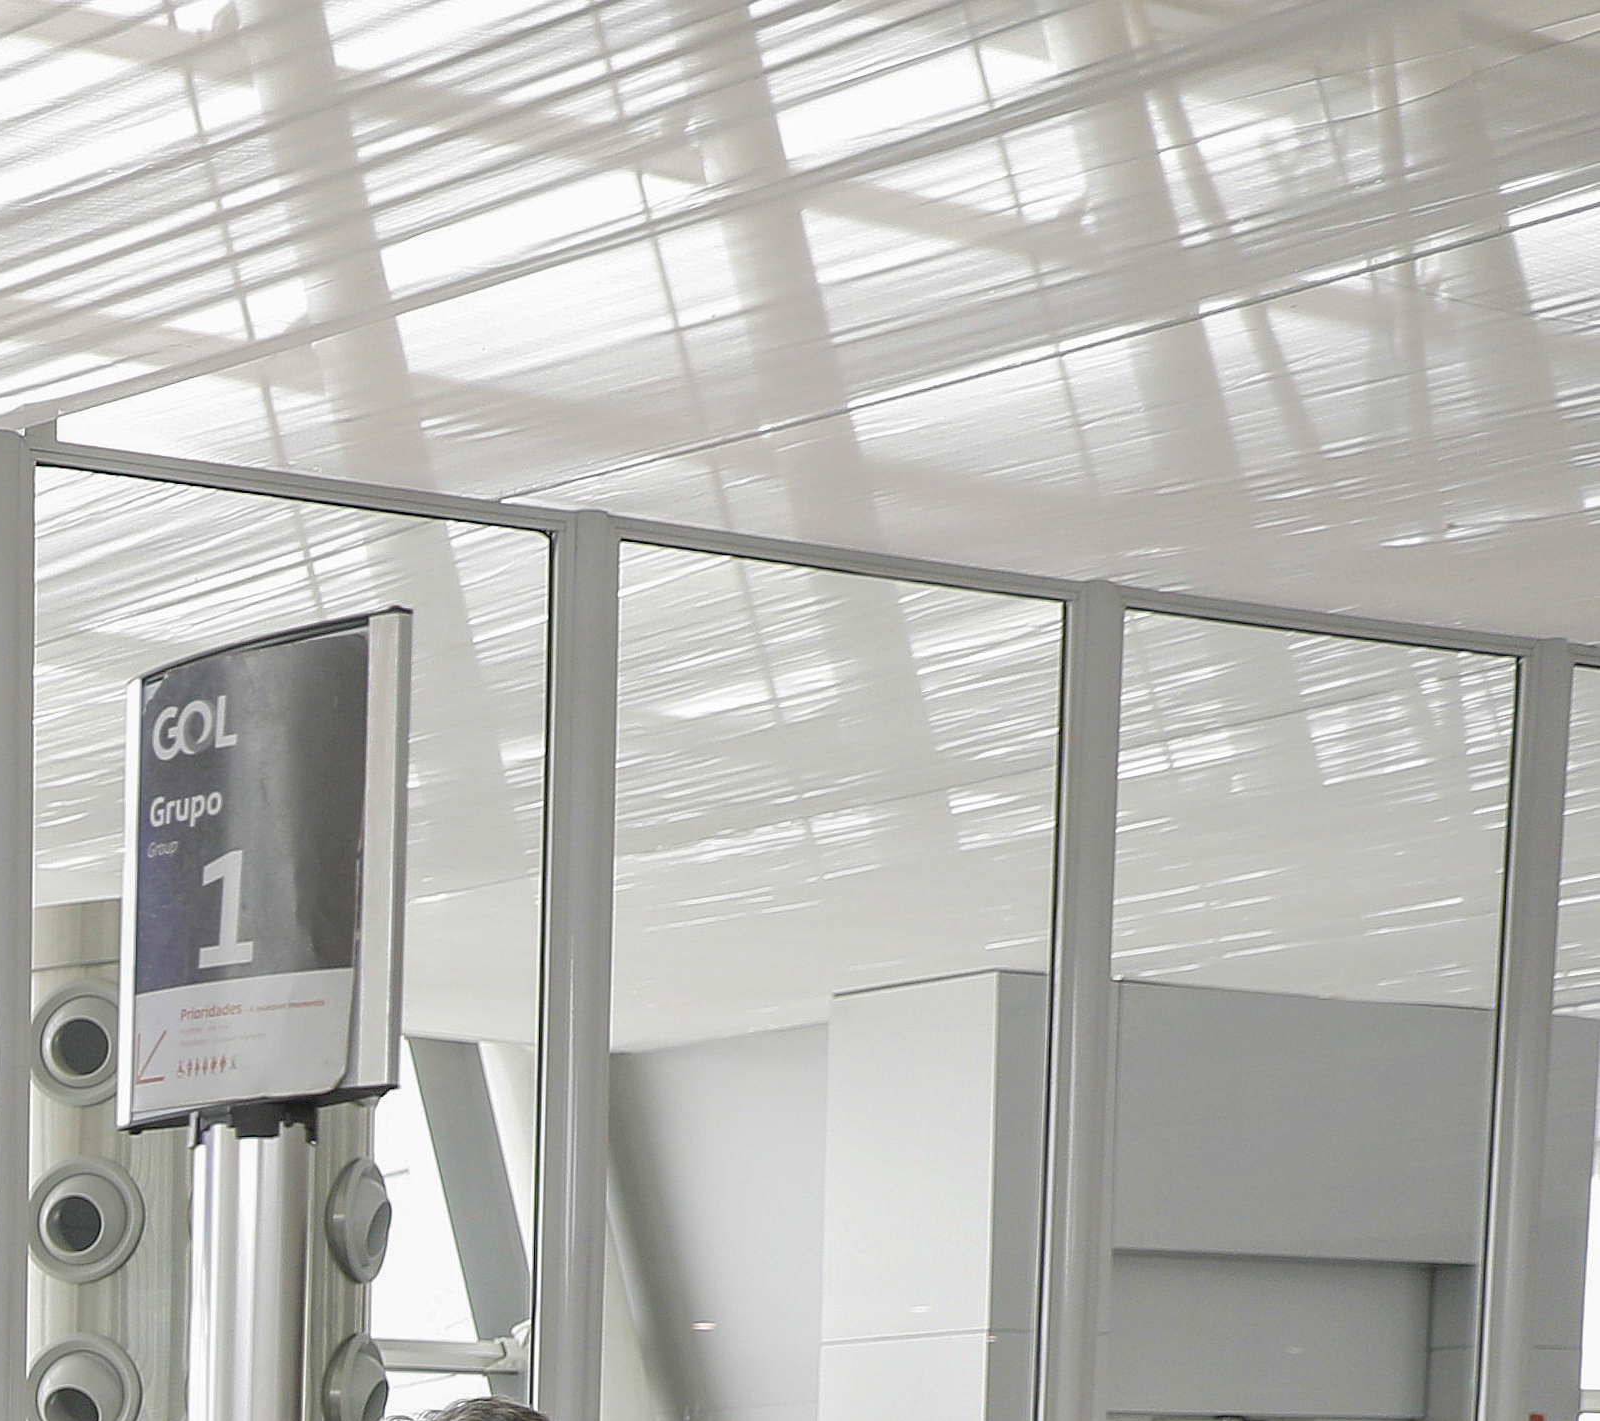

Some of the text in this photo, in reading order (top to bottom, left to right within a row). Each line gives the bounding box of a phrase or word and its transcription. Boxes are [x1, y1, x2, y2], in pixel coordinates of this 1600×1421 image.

[152, 694, 237, 761] GOL
[149, 790, 223, 828] Grupo
[198, 849, 254, 970] 1
